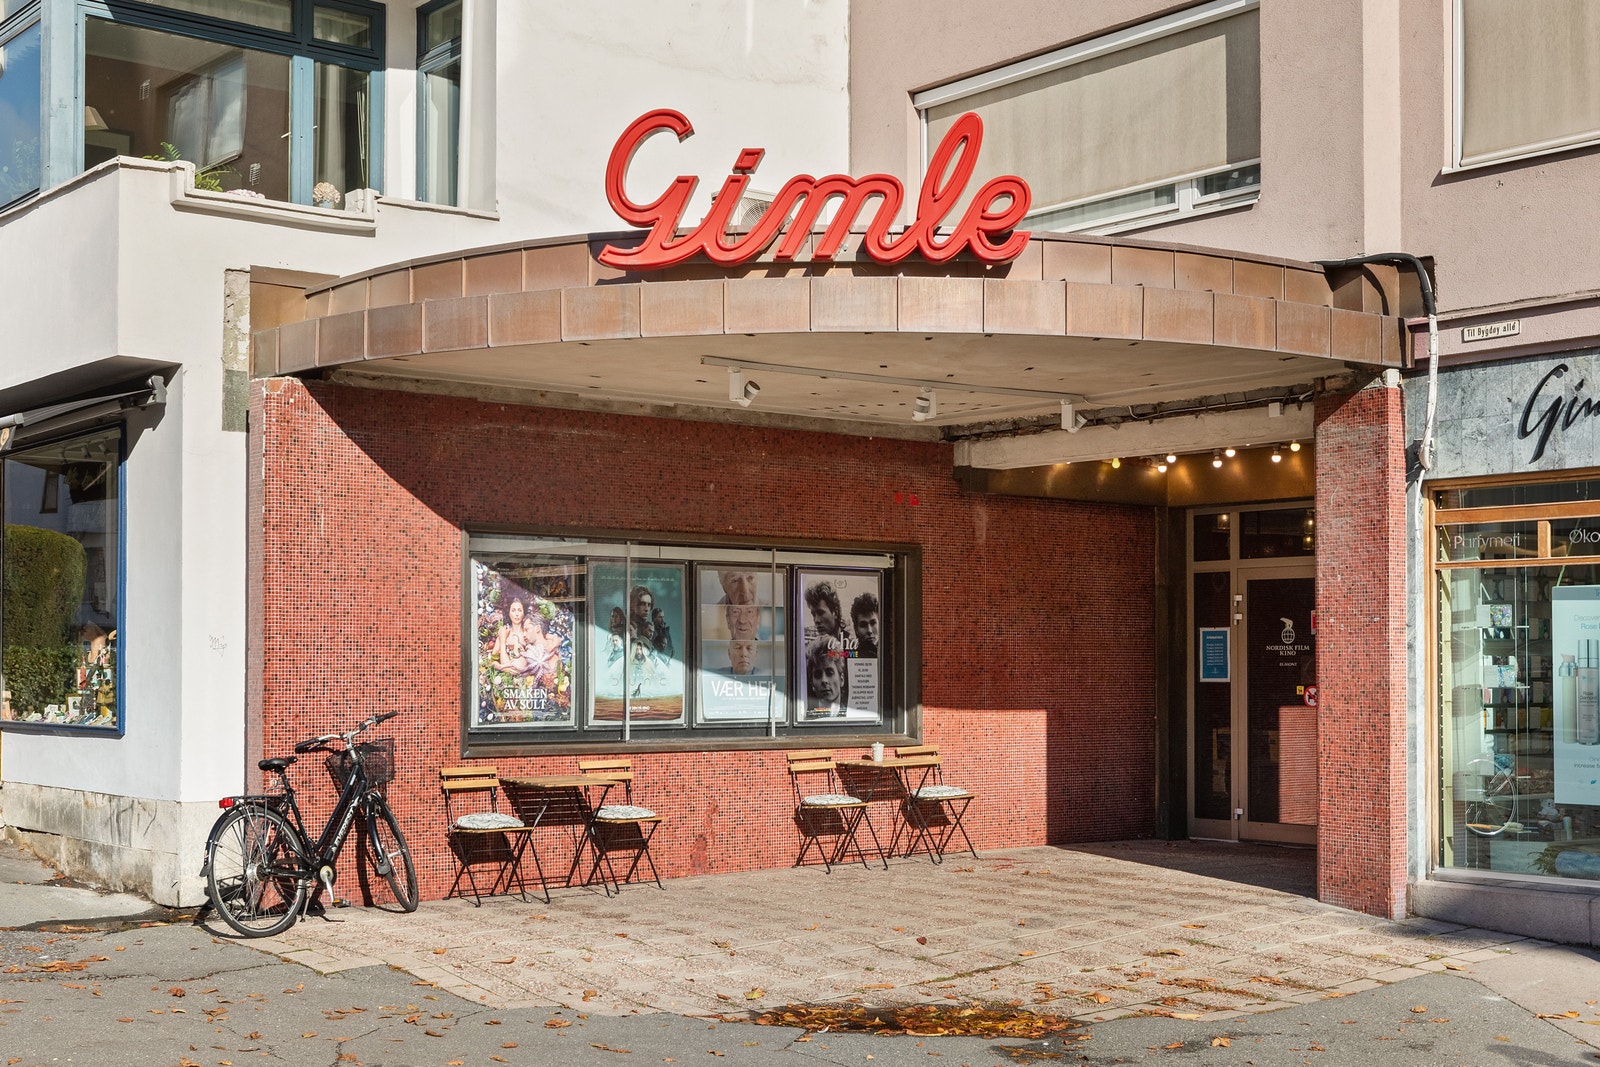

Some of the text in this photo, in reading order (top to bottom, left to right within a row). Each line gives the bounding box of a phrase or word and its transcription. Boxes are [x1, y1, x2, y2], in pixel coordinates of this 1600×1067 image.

[598, 108, 1031, 270] Gimle
[1467, 328, 1475, 338] Til
[1454, 532, 1521, 550] Parfymeri
[503, 688, 549, 699] SMAKEN
[711, 680, 744, 697] VÆR
[503, 699, 548, 710] AV SULT
